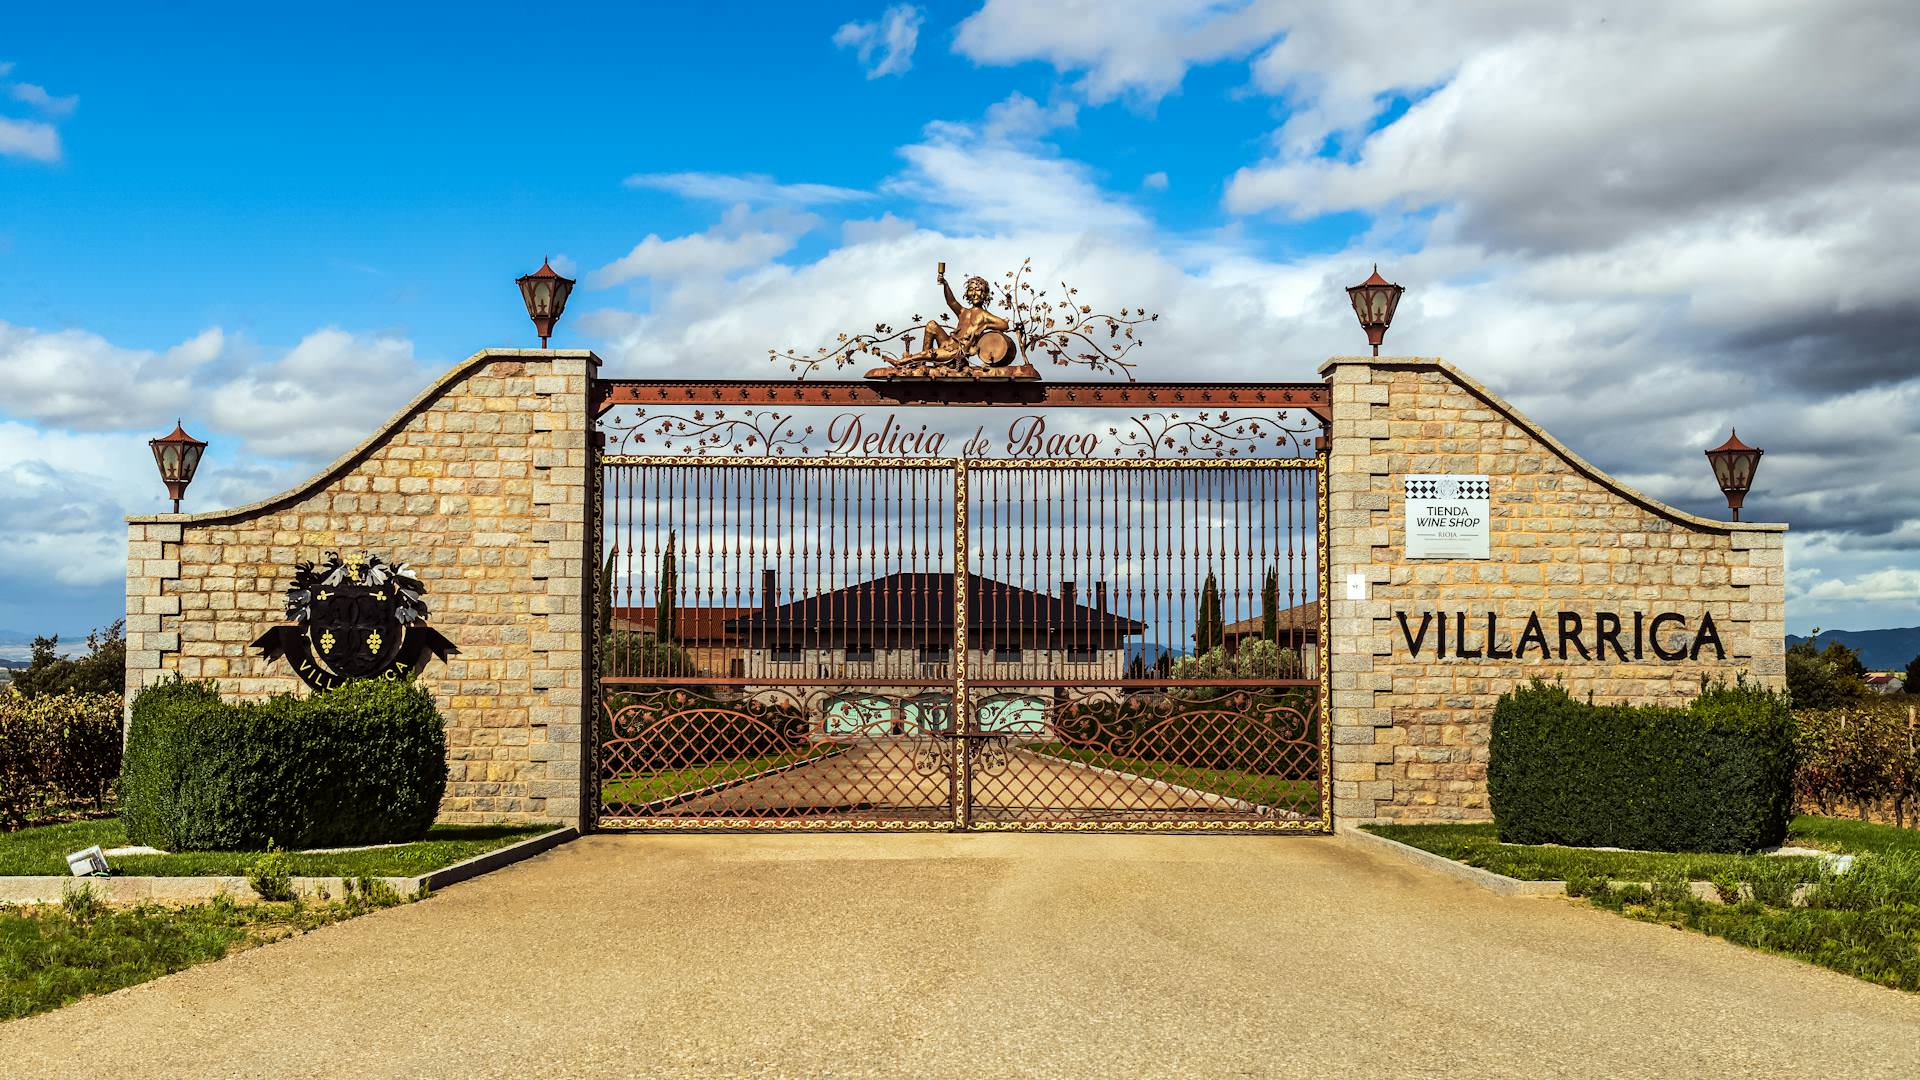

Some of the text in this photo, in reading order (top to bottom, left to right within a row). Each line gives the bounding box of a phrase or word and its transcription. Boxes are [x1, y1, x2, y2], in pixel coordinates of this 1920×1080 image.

[825, 413, 1103, 456] Delicia de Baco
[1416, 517, 1480, 528] WINE SHOP
[1426, 506, 1469, 516] TIENDA
[1396, 610, 1726, 662] VILLARRICA
[300, 659, 408, 691] VILLCA
